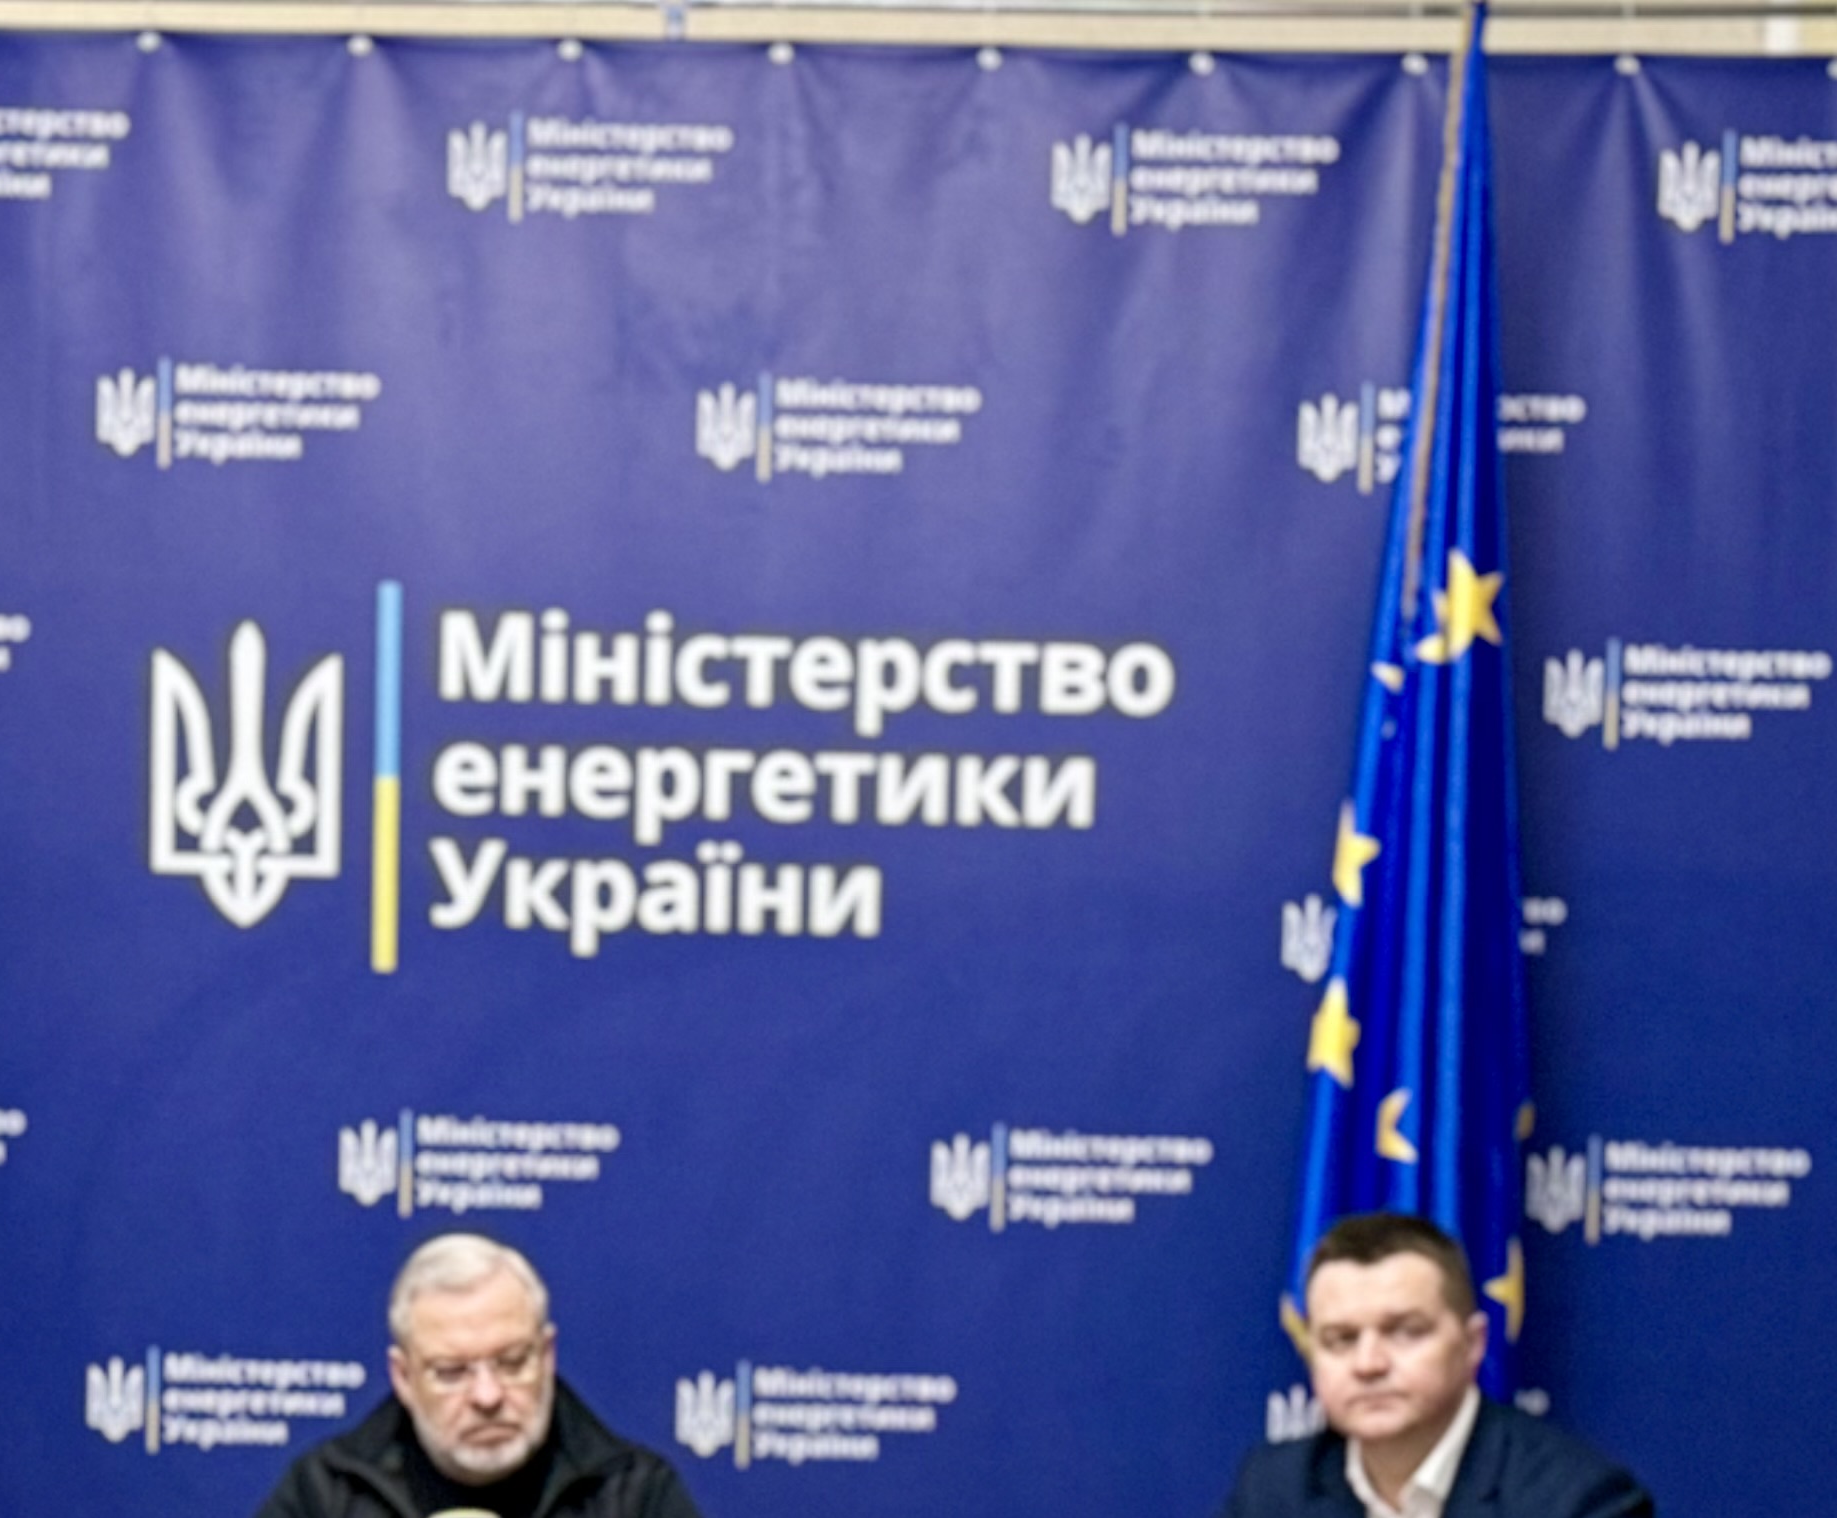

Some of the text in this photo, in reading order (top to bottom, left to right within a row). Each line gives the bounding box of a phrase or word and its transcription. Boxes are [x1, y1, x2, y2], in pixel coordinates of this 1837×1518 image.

[528, 119, 732, 162] Міністерство
[1132, 131, 1339, 174] Міністерство
[526, 158, 711, 193] енергетики
[1130, 170, 1318, 205] енергетики
[526, 186, 654, 217] України
[1130, 198, 1260, 229] України
[176, 365, 380, 408] Міністерство
[777, 380, 981, 422] Міністерство
[174, 404, 359, 439] енергетики
[775, 418, 960, 452] енергетики
[174, 432, 302, 463] України
[775, 446, 903, 476] України
[438, 607, 1177, 737] Міністерство
[1624, 646, 1831, 689] Міністерство
[1622, 685, 1810, 719] енергетики
[1622, 712, 1752, 743] України
[432, 739, 1098, 845] енергетики
[427, 836, 883, 958] України
[417, 1116, 619, 1158] Міністерство
[1009, 1130, 1212, 1172] Міністерство
[415, 1154, 599, 1188] енергетики
[1605, 1142, 1810, 1184] Міністерство
[415, 1182, 541, 1212] України
[1007, 1168, 1192, 1202] енергетики
[1603, 1180, 1789, 1214] енергетики
[1007, 1196, 1134, 1226] України
[1603, 1208, 1731, 1238] України
[165, 1354, 365, 1395] Міністерство
[754, 1368, 956, 1410] Міністерство
[163, 1392, 345, 1425] енергетики
[752, 1406, 936, 1440] енергетики
[163, 1418, 288, 1448] України
[752, 1433, 878, 1463] України
